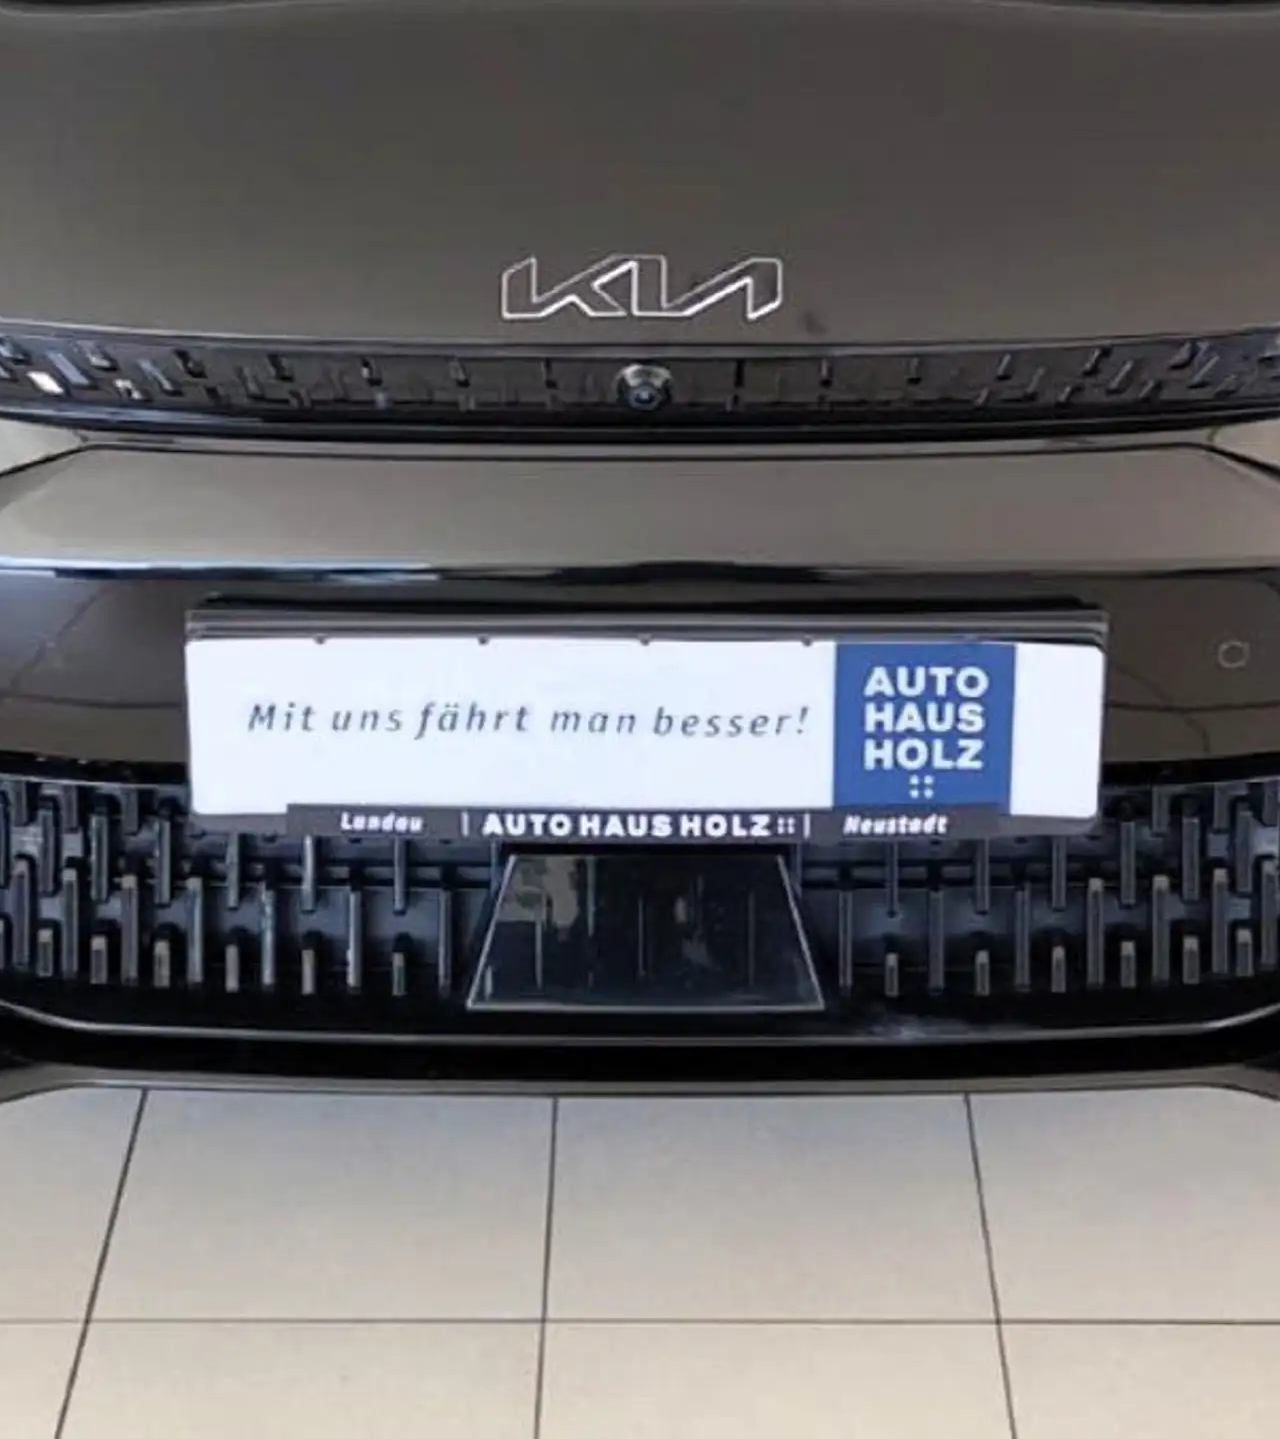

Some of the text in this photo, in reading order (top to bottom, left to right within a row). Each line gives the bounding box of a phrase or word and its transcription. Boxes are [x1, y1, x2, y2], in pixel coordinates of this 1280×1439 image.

[501, 253, 784, 322] KIA
[863, 665, 989, 698] AUTO
[247, 701, 810, 741] Mit uns fährt man besser!
[863, 701, 986, 733] HAUS
[863, 737, 985, 770] HOLZ
[339, 811, 424, 834] Landau
[482, 812, 771, 838] AUTO HAUS HOLZ
[842, 814, 949, 836] Neustadt
